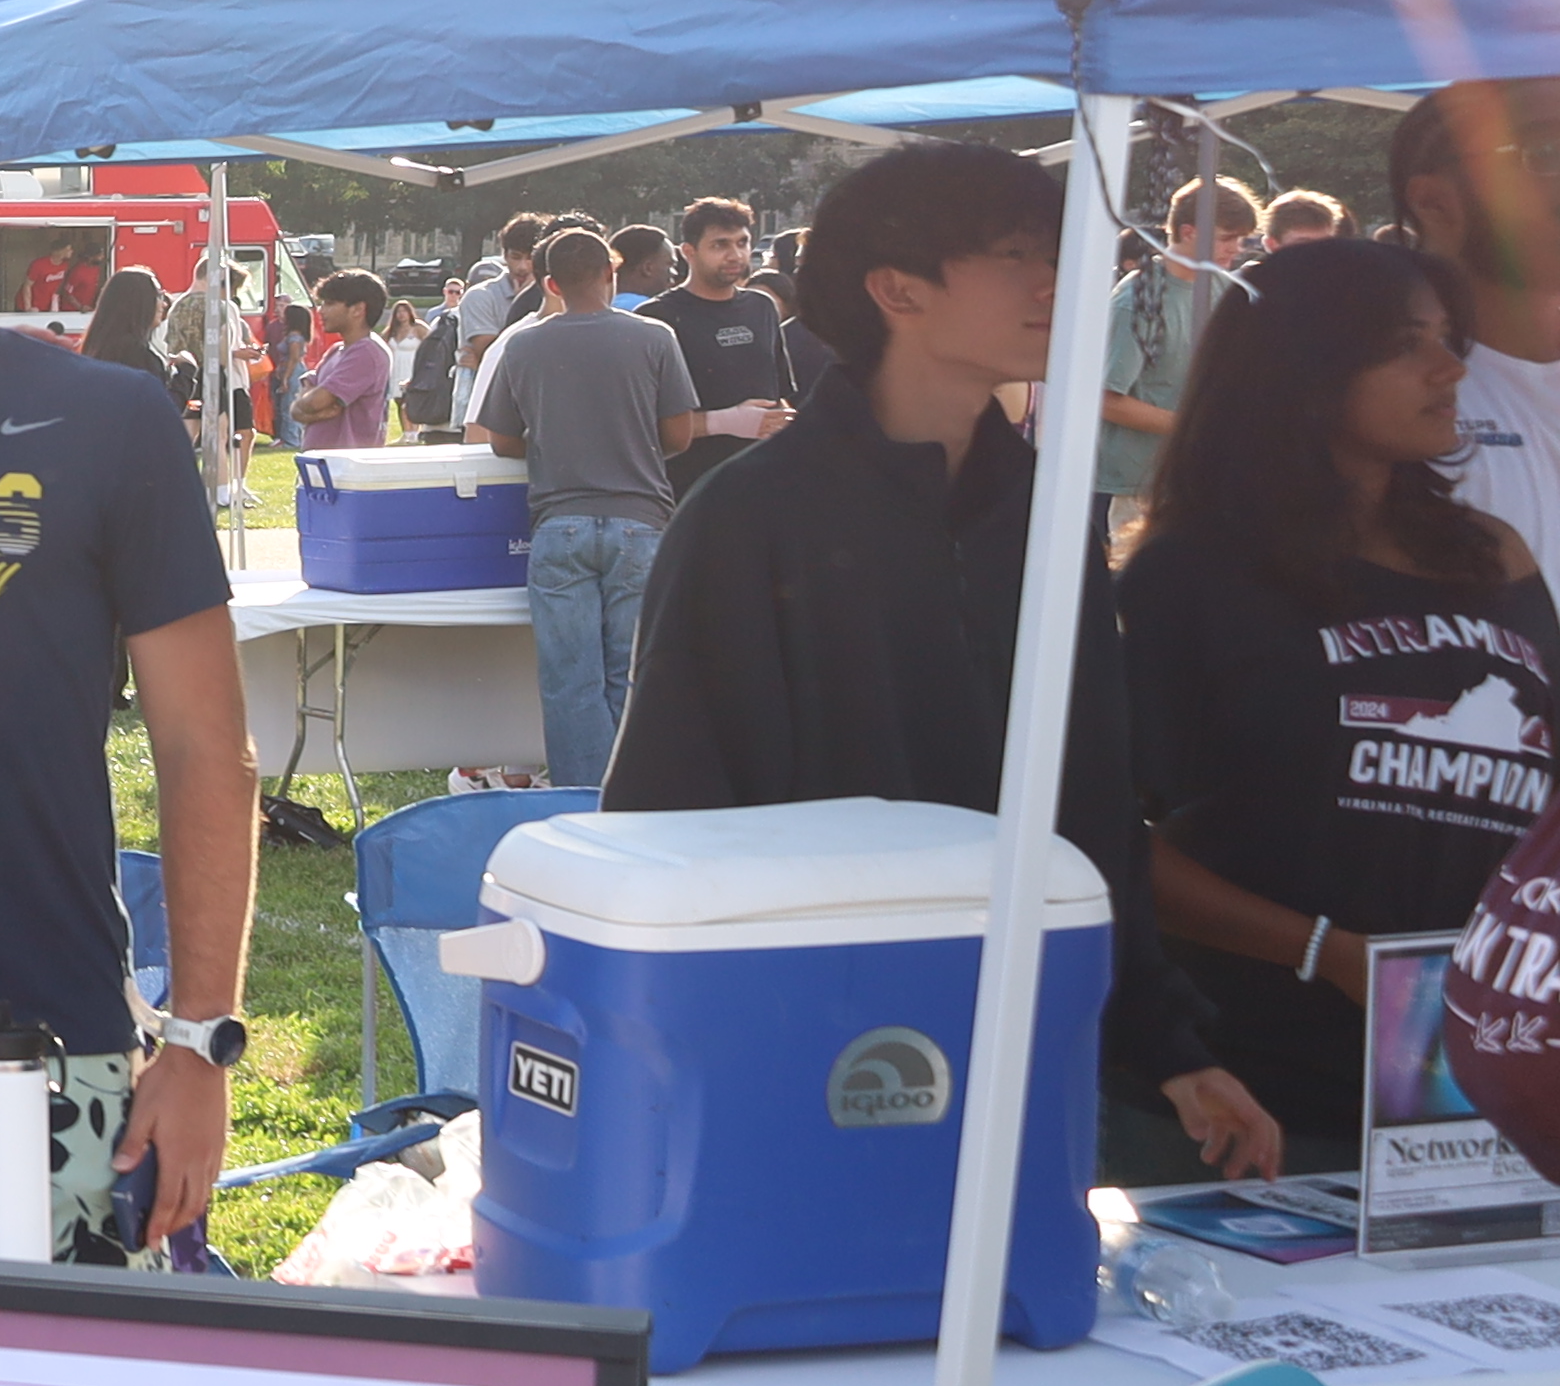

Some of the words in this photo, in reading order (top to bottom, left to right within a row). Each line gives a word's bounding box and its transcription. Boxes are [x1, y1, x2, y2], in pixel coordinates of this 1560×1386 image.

[1349, 699, 1390, 718] 2024
[515, 1053, 574, 1104] YETI
[841, 1089, 936, 1116] IGLOO
[1386, 1133, 1518, 1167] Network
